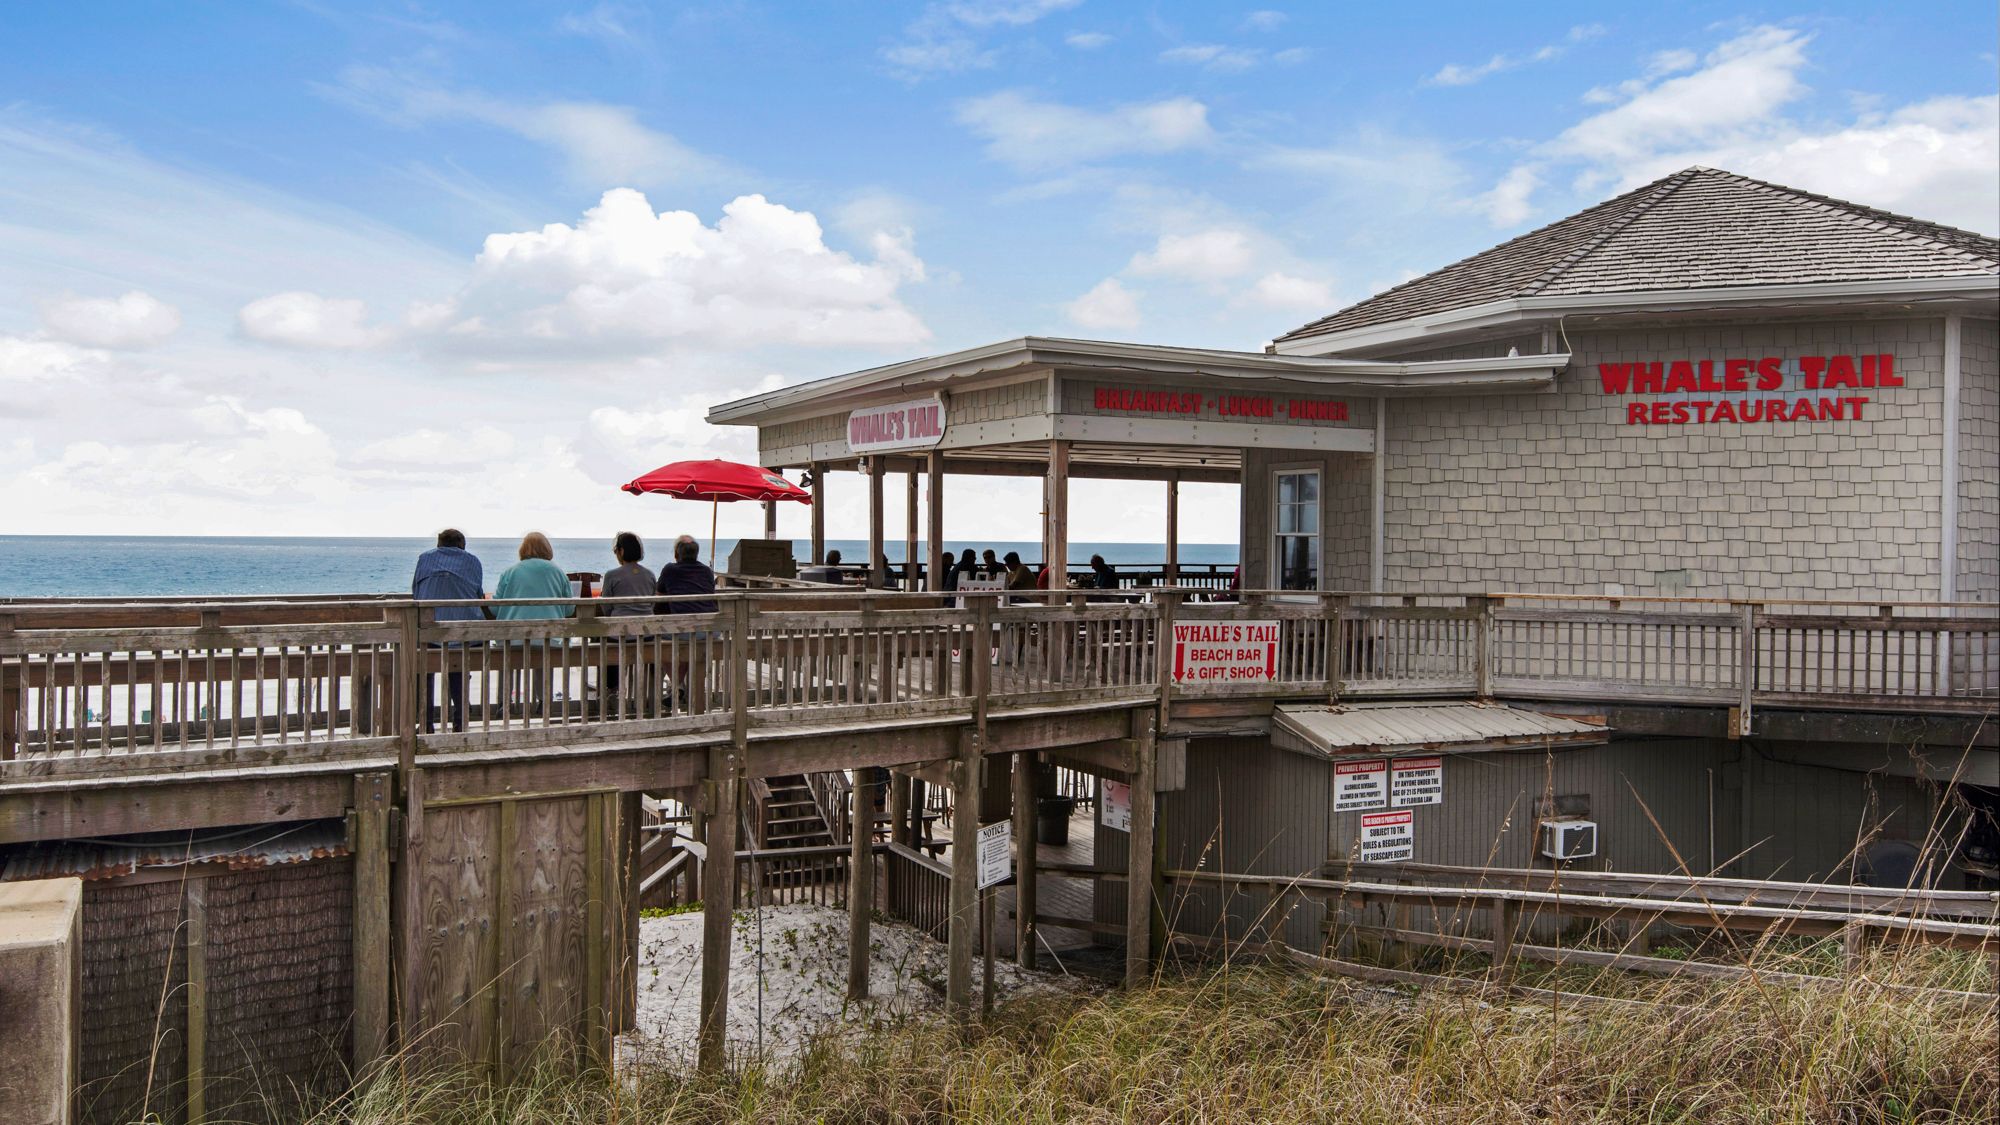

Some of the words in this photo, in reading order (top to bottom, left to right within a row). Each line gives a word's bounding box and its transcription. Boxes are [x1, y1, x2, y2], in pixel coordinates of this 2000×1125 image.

[1599, 357, 1783, 394] WHALE'S
[1800, 354, 1904, 389] TAIL
[1094, 388, 1204, 414] BREAKFAST
[1219, 396, 1274, 417] LUNCH
[1289, 400, 1348, 421] DINNER
[1627, 397, 1869, 425] RESTAURANT
[850, 410, 905, 445] WHALE'S
[908, 405, 942, 439] TAIL
[1174, 625, 1242, 642] WHALE'S
[1246, 625, 1279, 642] TAIL
[1191, 649, 1233, 661] BEACH
[1236, 649, 1262, 661] BAR
[1186, 667, 1195, 680] &
[1198, 667, 1227, 679] GIFT
[1230, 666, 1264, 678] SHOP
[1359, 762, 1384, 772] PROPERTY
[1415, 769, 1436, 777] PROPERTY
[1401, 788, 1406, 796] OF
[1417, 786, 1441, 794] PROHIBITED
[1407, 796, 1423, 804] FLORIDA
[983, 824, 1005, 840] NOTICE
[1370, 827, 1390, 837] SUBJECT
[1391, 826, 1397, 835] TO
[1397, 826, 1405, 834] THE
[1363, 840, 1376, 850] RULES
[1383, 837, 1411, 848] REGULATIONS
[1364, 853, 1370, 862] OF
[1370, 850, 1394, 861] SEASCAPE
[1394, 849, 1411, 859] RESORT
